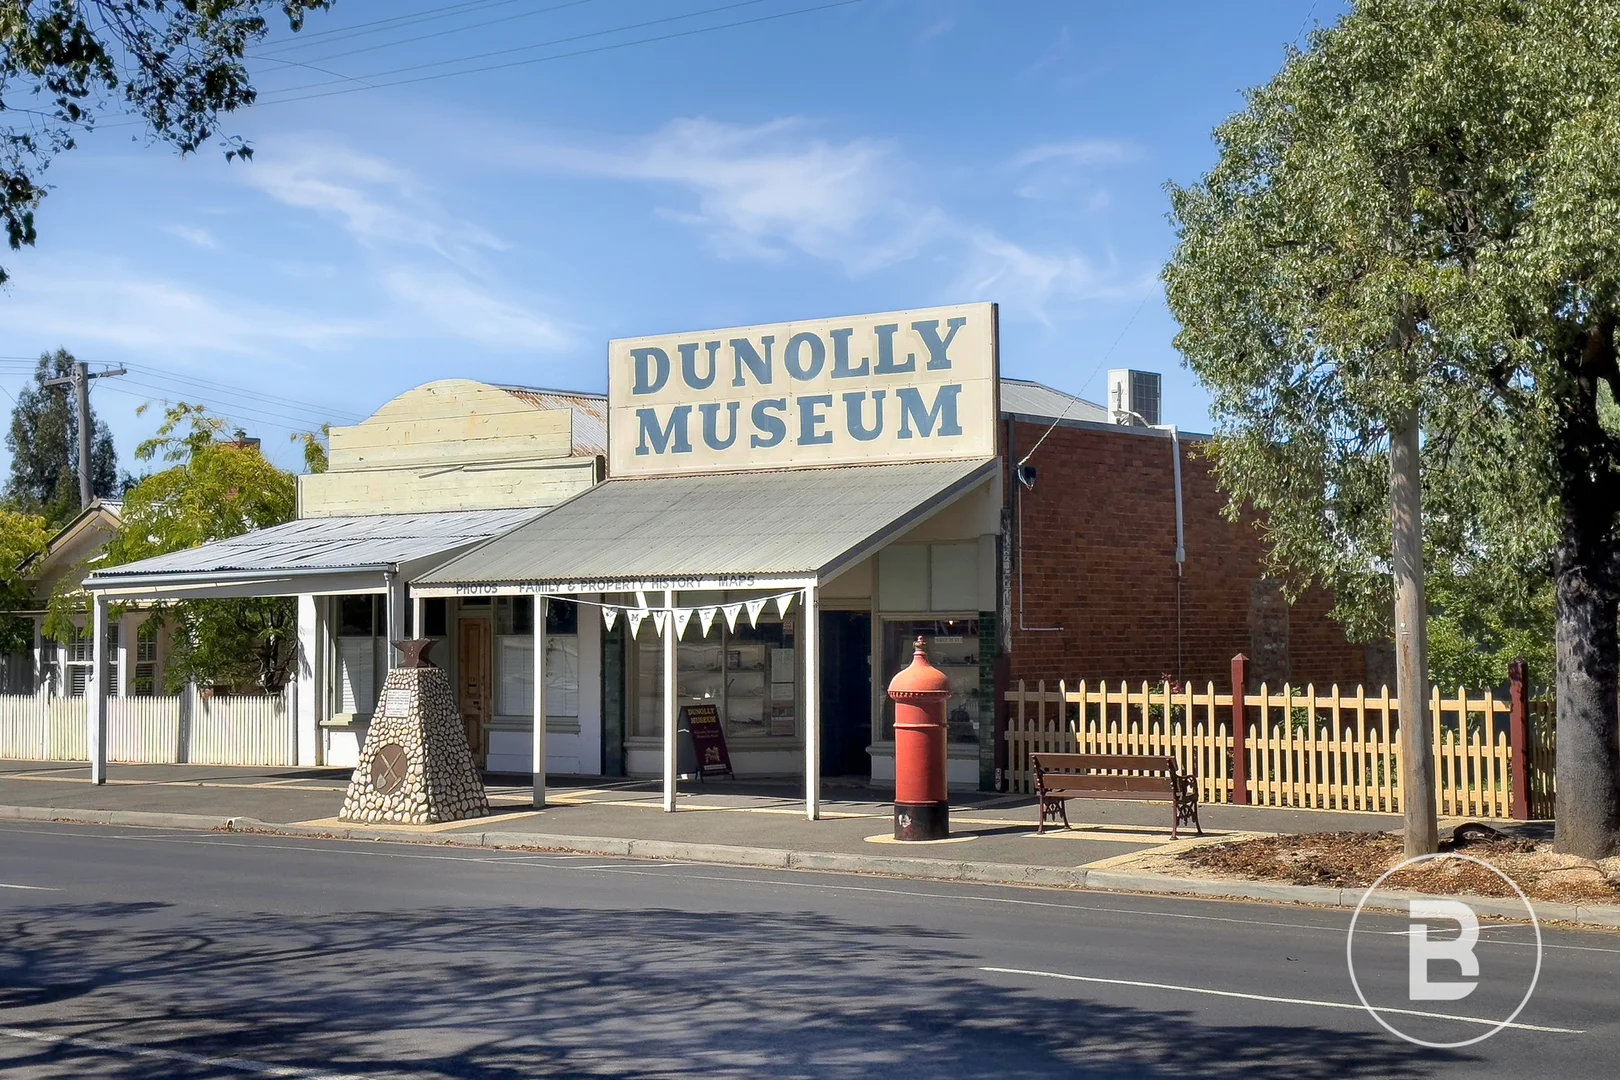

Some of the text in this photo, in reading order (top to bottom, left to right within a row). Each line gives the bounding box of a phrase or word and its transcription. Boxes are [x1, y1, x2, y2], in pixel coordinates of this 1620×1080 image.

[629, 316, 967, 396] DUNOLLY
[635, 384, 963, 456] MUSEUM
[456, 575, 755, 595] PHOTOS FAMILY & PROPERTY HISTORY MAPS
